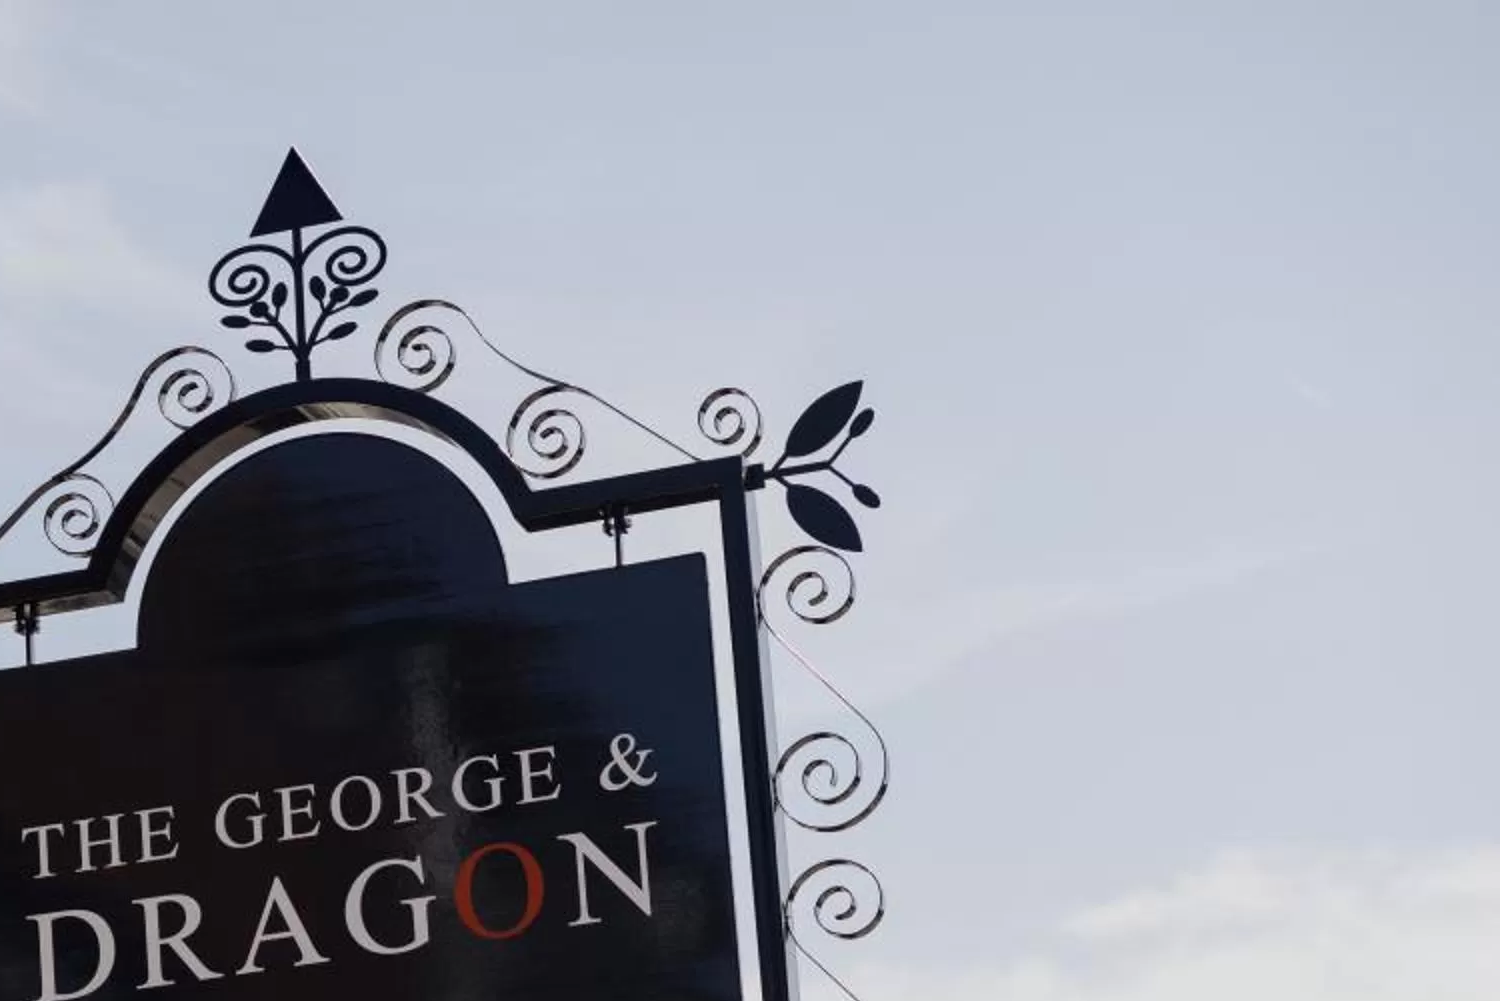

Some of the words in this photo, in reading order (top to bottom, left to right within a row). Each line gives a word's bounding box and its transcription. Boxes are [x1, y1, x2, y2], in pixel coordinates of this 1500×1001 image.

[21, 805, 180, 880] THE
[214, 745, 562, 850] GEORGE
[600, 732, 658, 791] &
